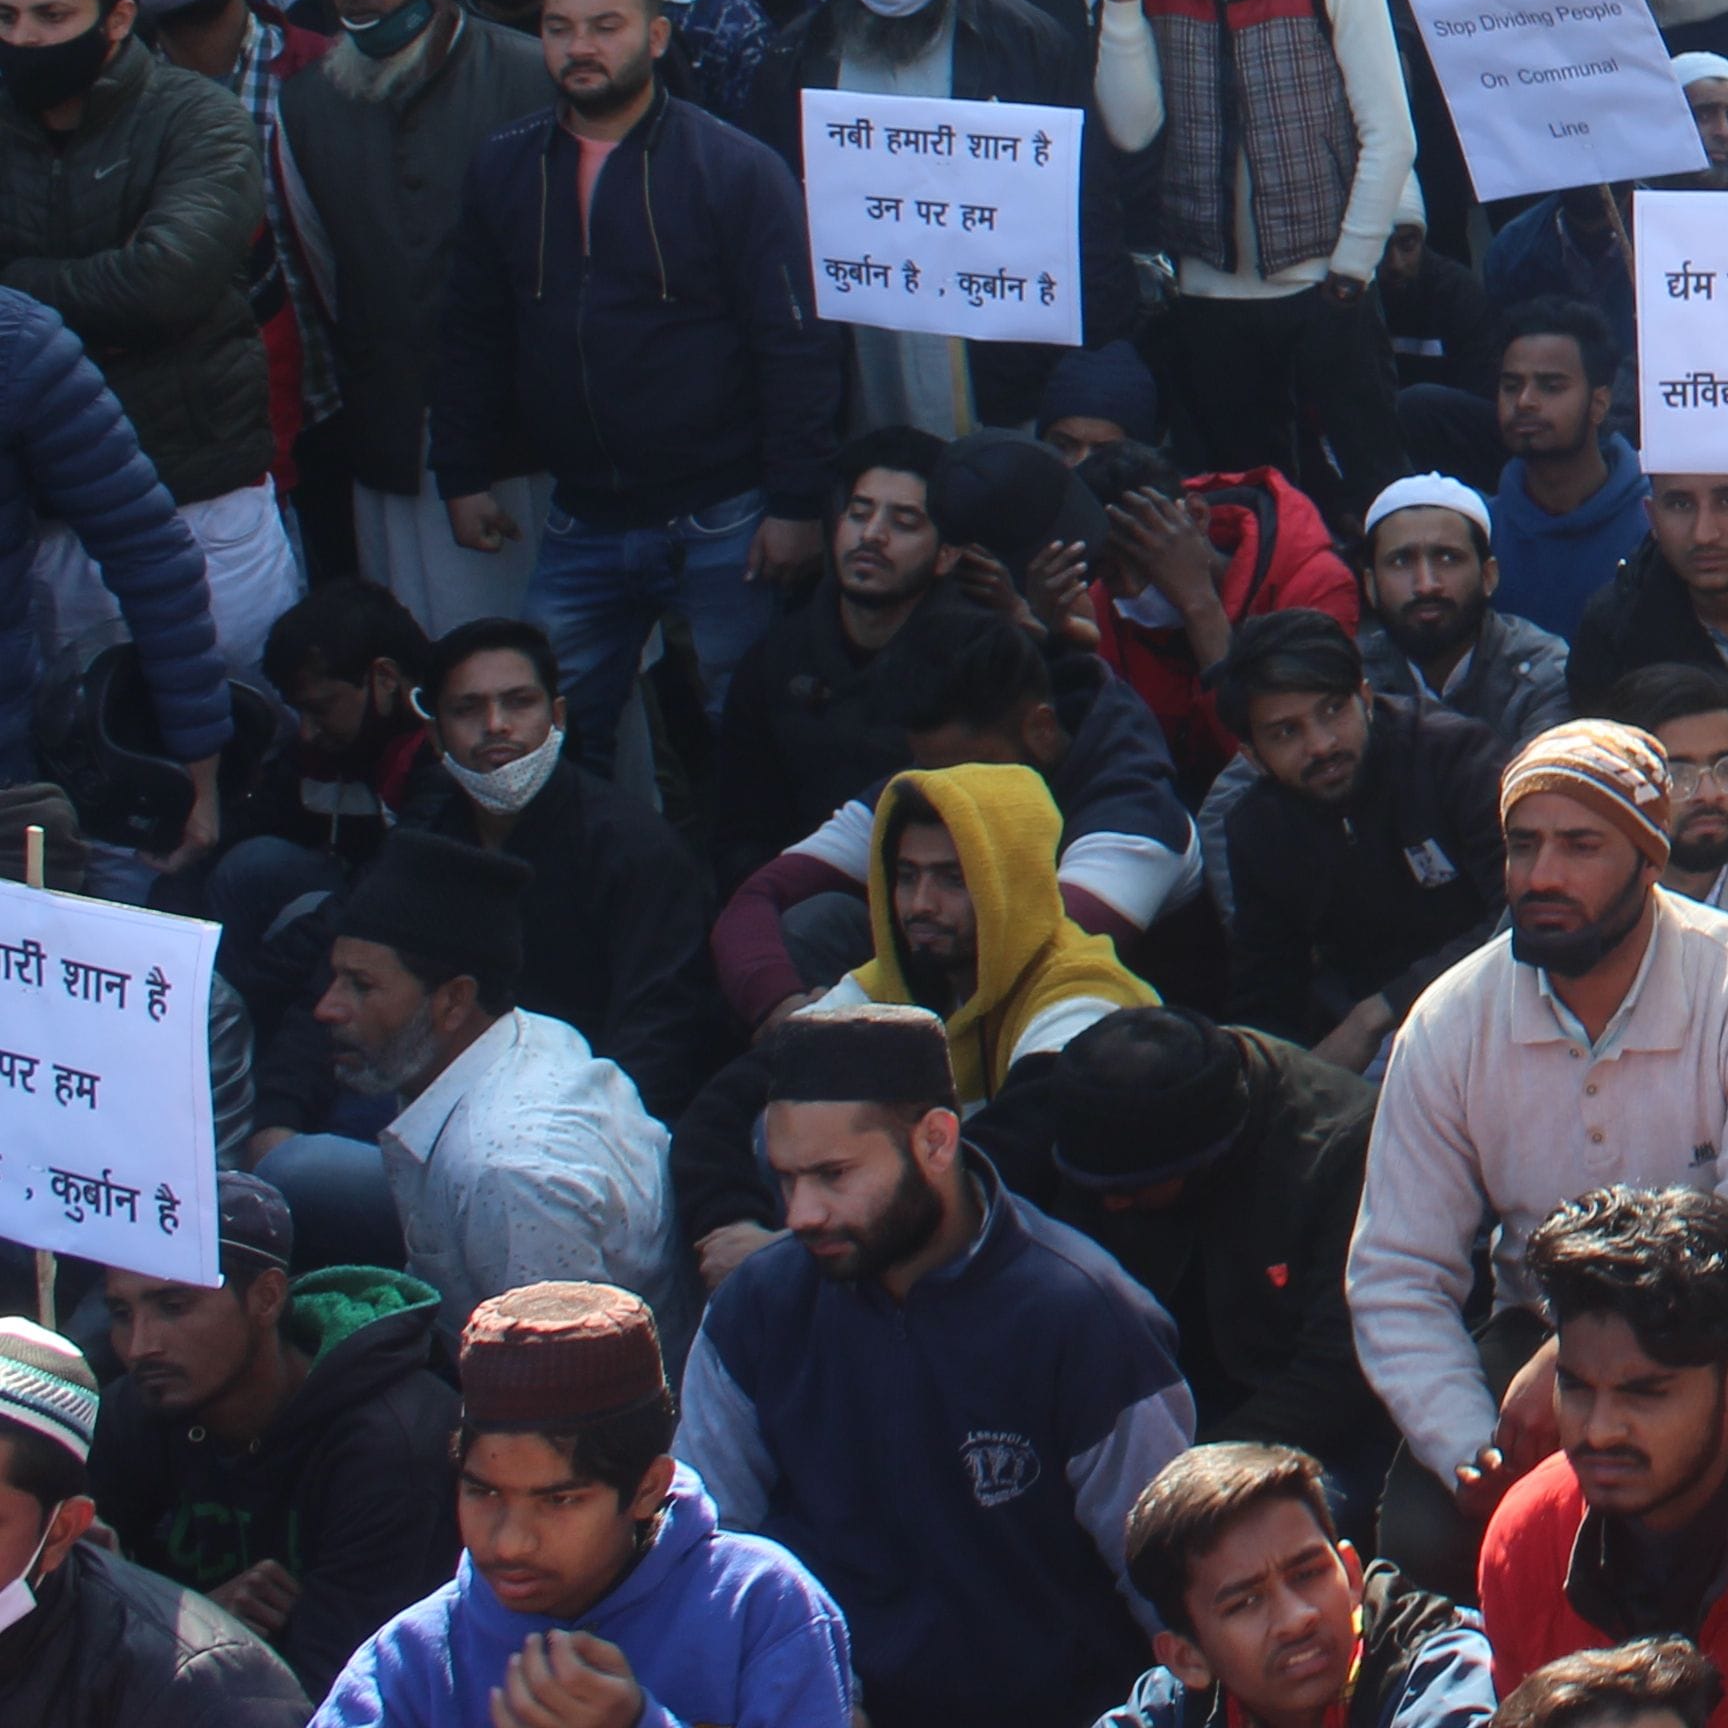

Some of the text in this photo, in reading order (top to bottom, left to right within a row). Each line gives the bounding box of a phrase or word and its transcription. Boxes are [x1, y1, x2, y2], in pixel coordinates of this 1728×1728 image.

[1433, 1, 1622, 38] Stop Dividing People
[1480, 57, 1619, 90] On Communal
[826, 118, 1053, 168] नबी हमारी शान है
[1548, 119, 1590, 139] Line
[864, 195, 998, 233] उन पर हम
[823, 254, 893, 293] कुर्बान
[901, 259, 922, 294] है
[956, 267, 1028, 308] कुर्बान
[1037, 271, 1057, 306] है
[0, 939, 172, 1023] ारी शान है
[52, 1062, 101, 1111] हम
[49, 1165, 141, 1224] कुर्बान
[154, 1182, 183, 1236] है
